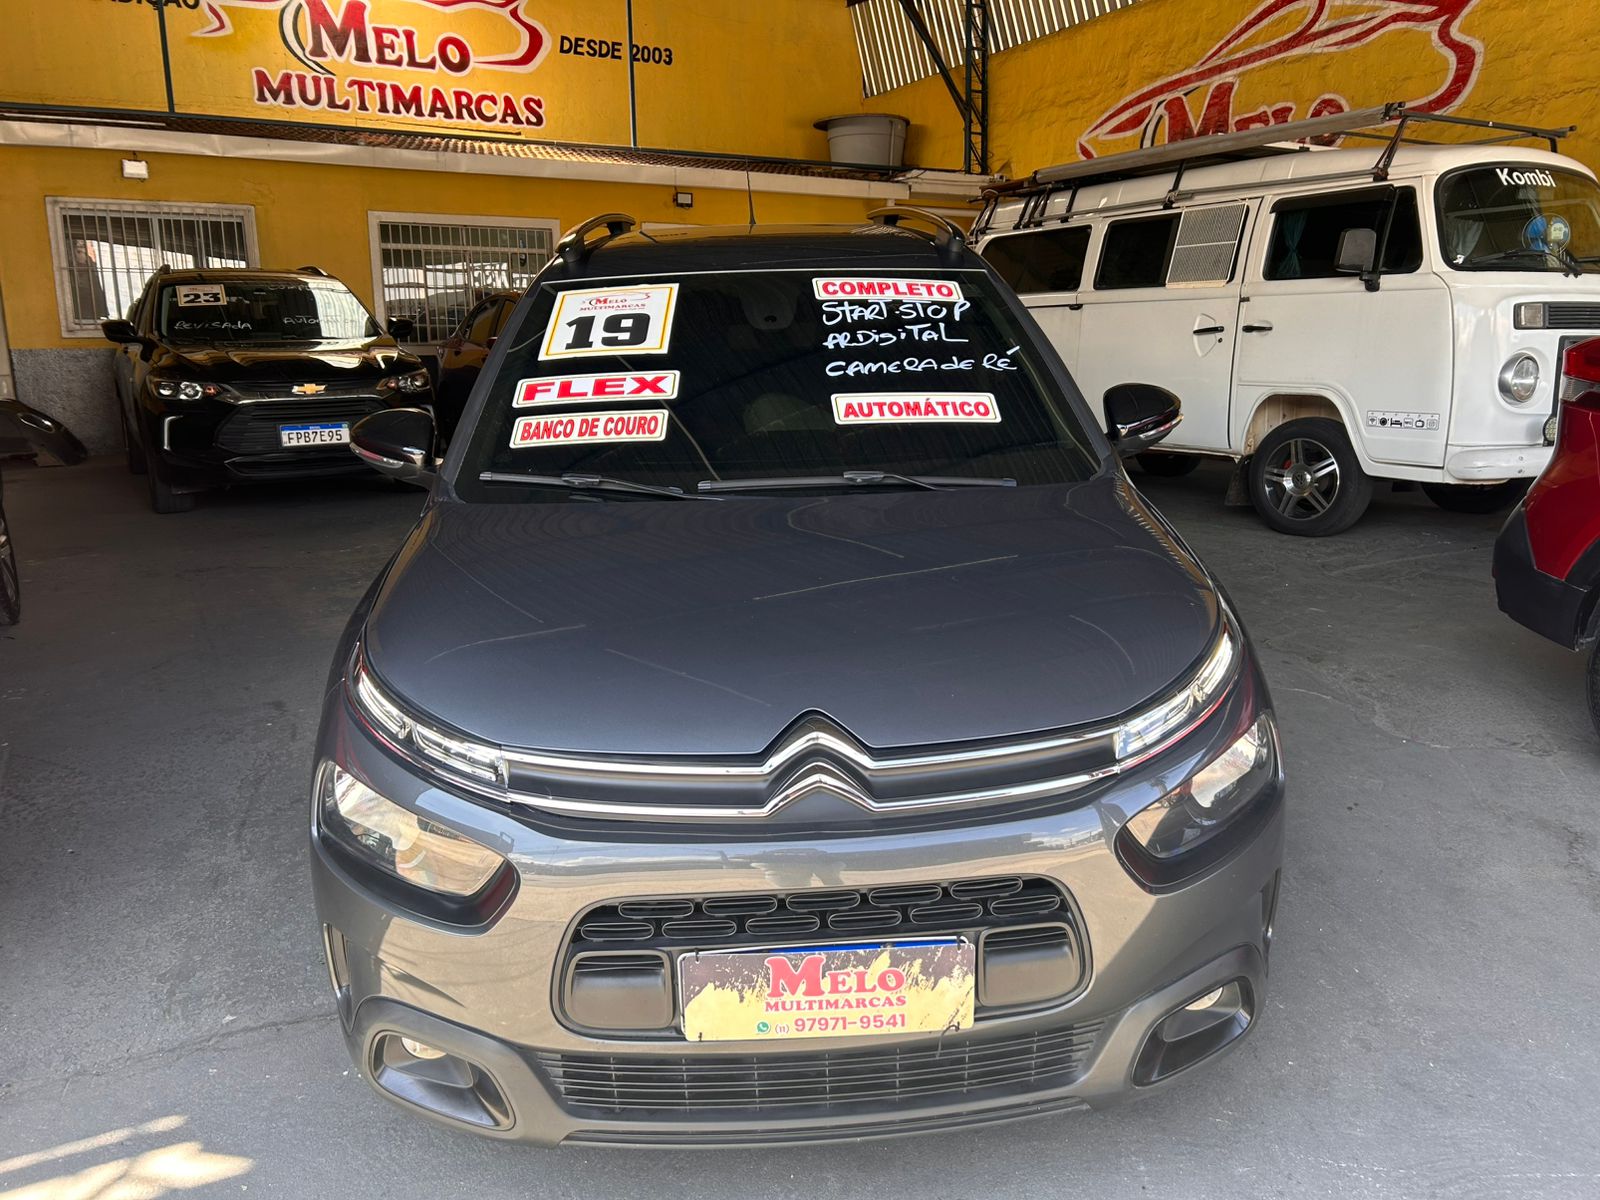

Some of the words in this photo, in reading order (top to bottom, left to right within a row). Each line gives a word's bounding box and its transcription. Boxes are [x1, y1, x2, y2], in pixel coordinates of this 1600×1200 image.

[304, 0, 472, 73] MELO
[559, 35, 623, 60] DESDE
[631, 44, 673, 66] 2003
[254, 70, 544, 127] MULTIMARCAS
[1495, 168, 1556, 188] Kombi
[183, 292, 221, 304] 23
[822, 281, 954, 298] COMPLETO
[579, 303, 646, 312] MULTIMARCAS
[564, 312, 651, 350] 19
[522, 376, 669, 402] FLEX
[843, 398, 991, 418] AUTOMÁTICO
[287, 429, 343, 444] FPB7E95
[520, 419, 575, 442] BANCO
[577, 417, 600, 437] DE
[603, 415, 659, 436] COURO
[764, 954, 906, 998] MELO
[764, 995, 907, 1013] MULTIMARCAS
[794, 1013, 906, 1033] 97971-9541
